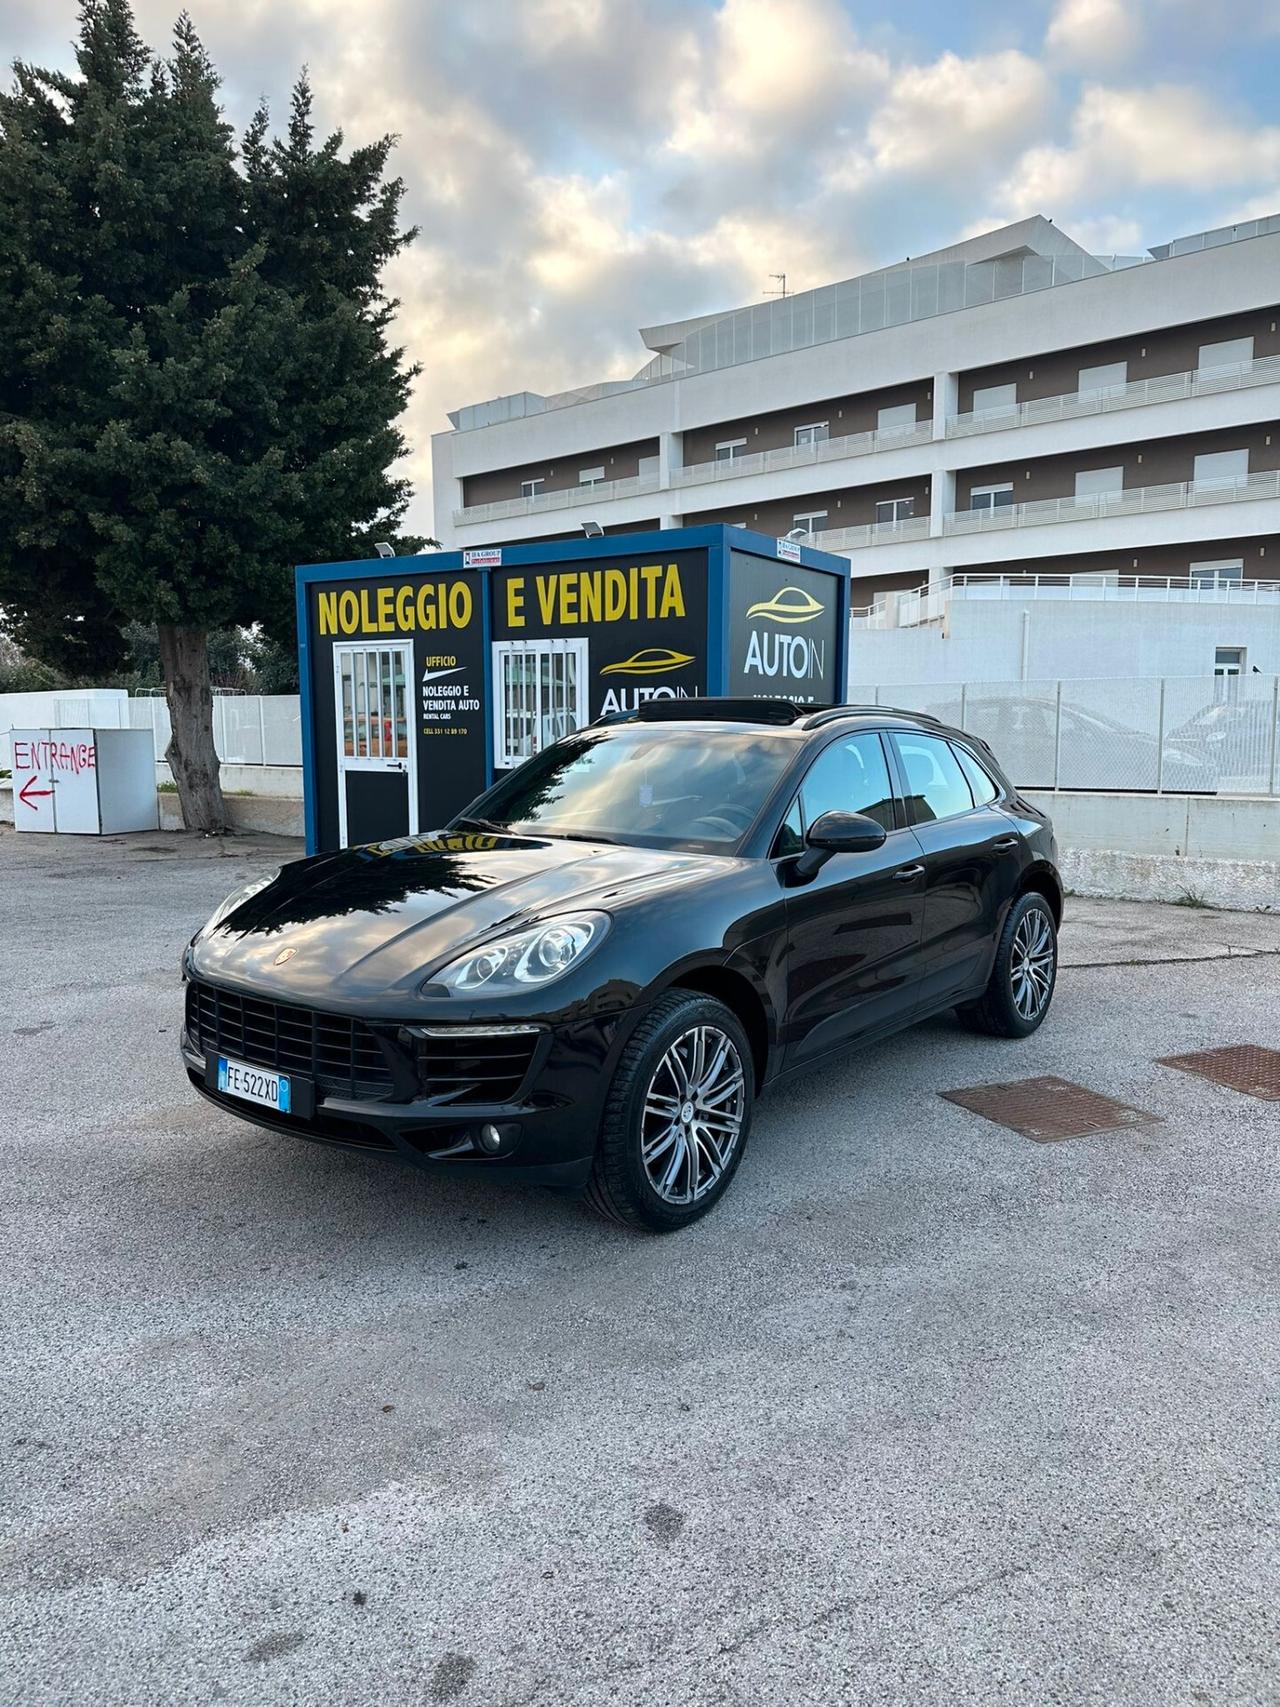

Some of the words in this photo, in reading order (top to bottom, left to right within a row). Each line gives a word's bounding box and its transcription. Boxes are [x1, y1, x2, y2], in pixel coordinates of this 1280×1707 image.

[318, 581, 473, 635] NOLEGGIO
[506, 577, 526, 628] E
[535, 563, 686, 625] VENDITA
[426, 655, 457, 667] UFFICIO
[422, 686, 462, 697] NOLEGGIO
[463, 685, 470, 696] E
[422, 700, 457, 711] VENDITA
[458, 699, 480, 711] AUTO
